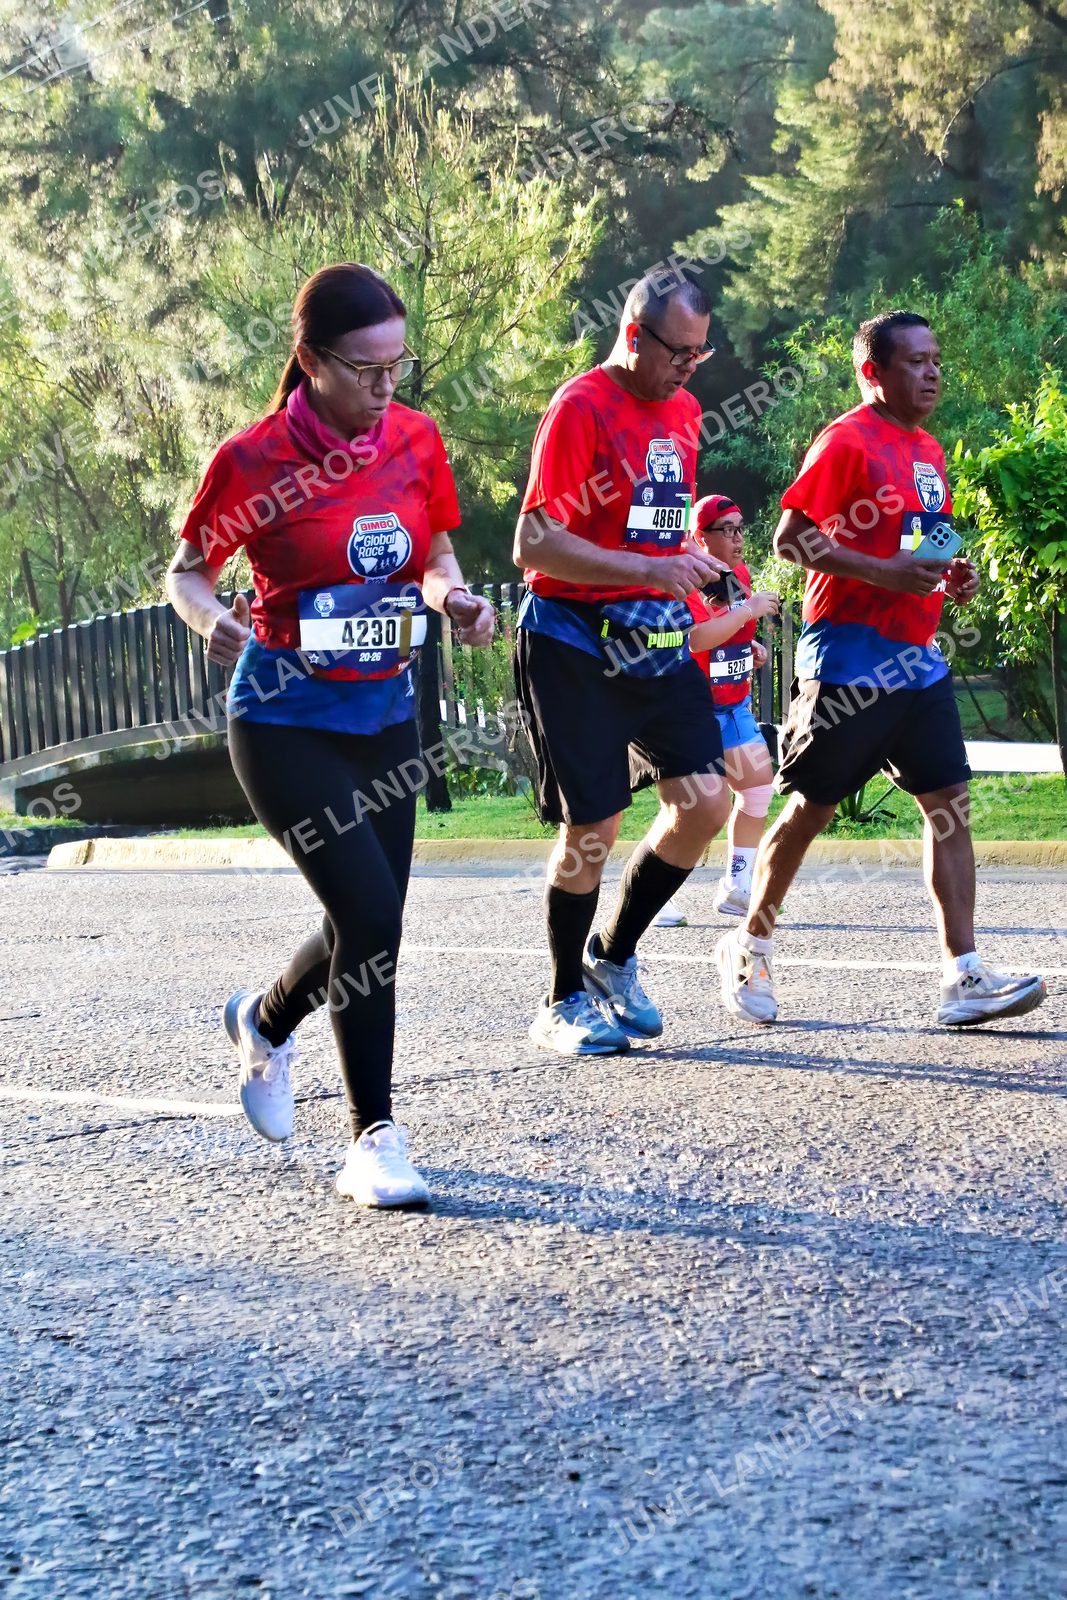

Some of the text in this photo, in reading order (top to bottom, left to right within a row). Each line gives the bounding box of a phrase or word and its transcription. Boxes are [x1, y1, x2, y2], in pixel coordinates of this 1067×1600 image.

[360, 519, 394, 531] BIMBO
[652, 508, 682, 529] 4860
[363, 531, 396, 547] Global
[357, 545, 385, 559] Race
[342, 618, 396, 647] 4230
[647, 630, 684, 648] PUMA
[359, 652, 382, 662] 20-26
